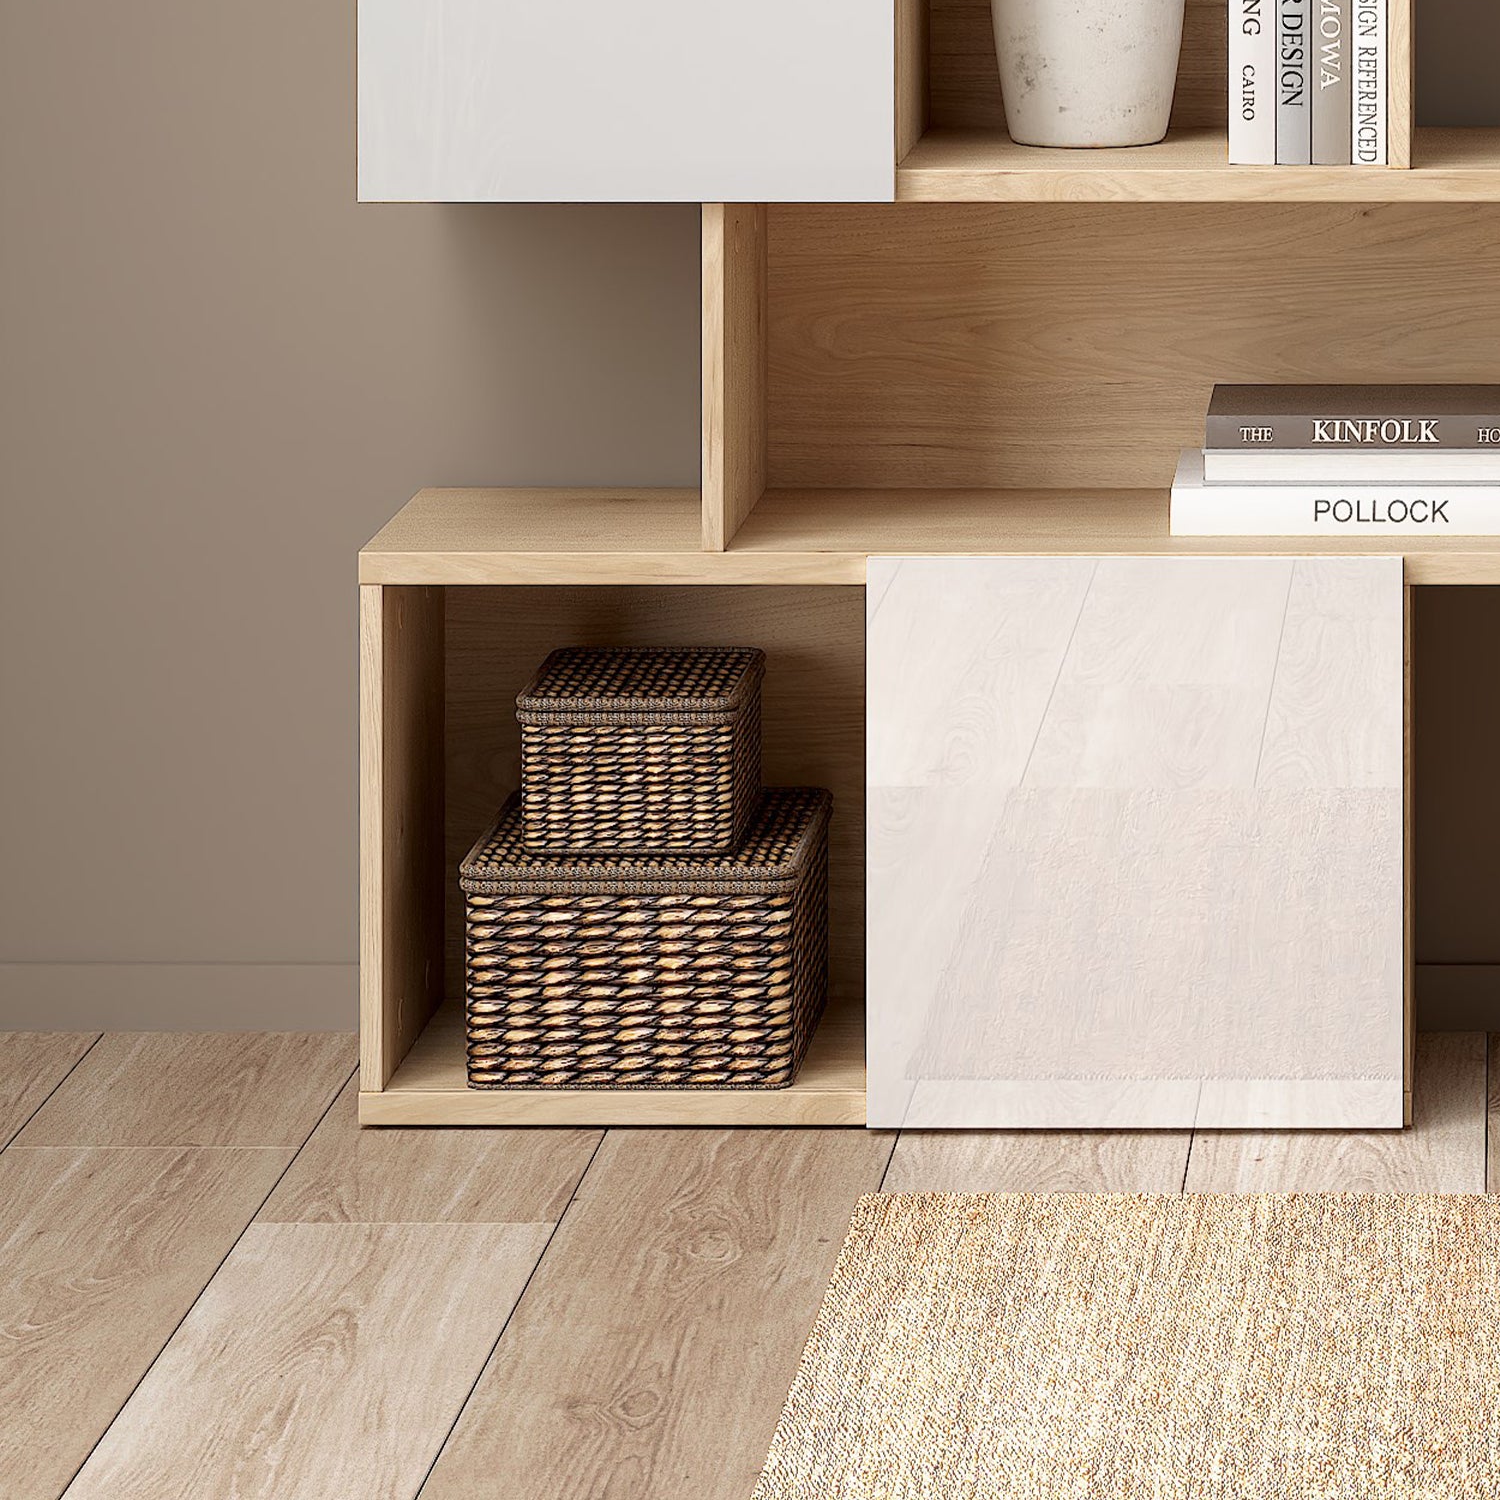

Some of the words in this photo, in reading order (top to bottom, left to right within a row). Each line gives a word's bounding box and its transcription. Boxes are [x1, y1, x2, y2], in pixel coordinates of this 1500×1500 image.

[1281, 14, 1304, 108] DESIGN
[1242, 64, 1255, 122] CAIRO
[1358, 47, 1378, 163] REFERENCED
[1239, 426, 1274, 442] THE
[1311, 418, 1440, 443] KINFOLK
[1313, 499, 1450, 523] POLLOCK
